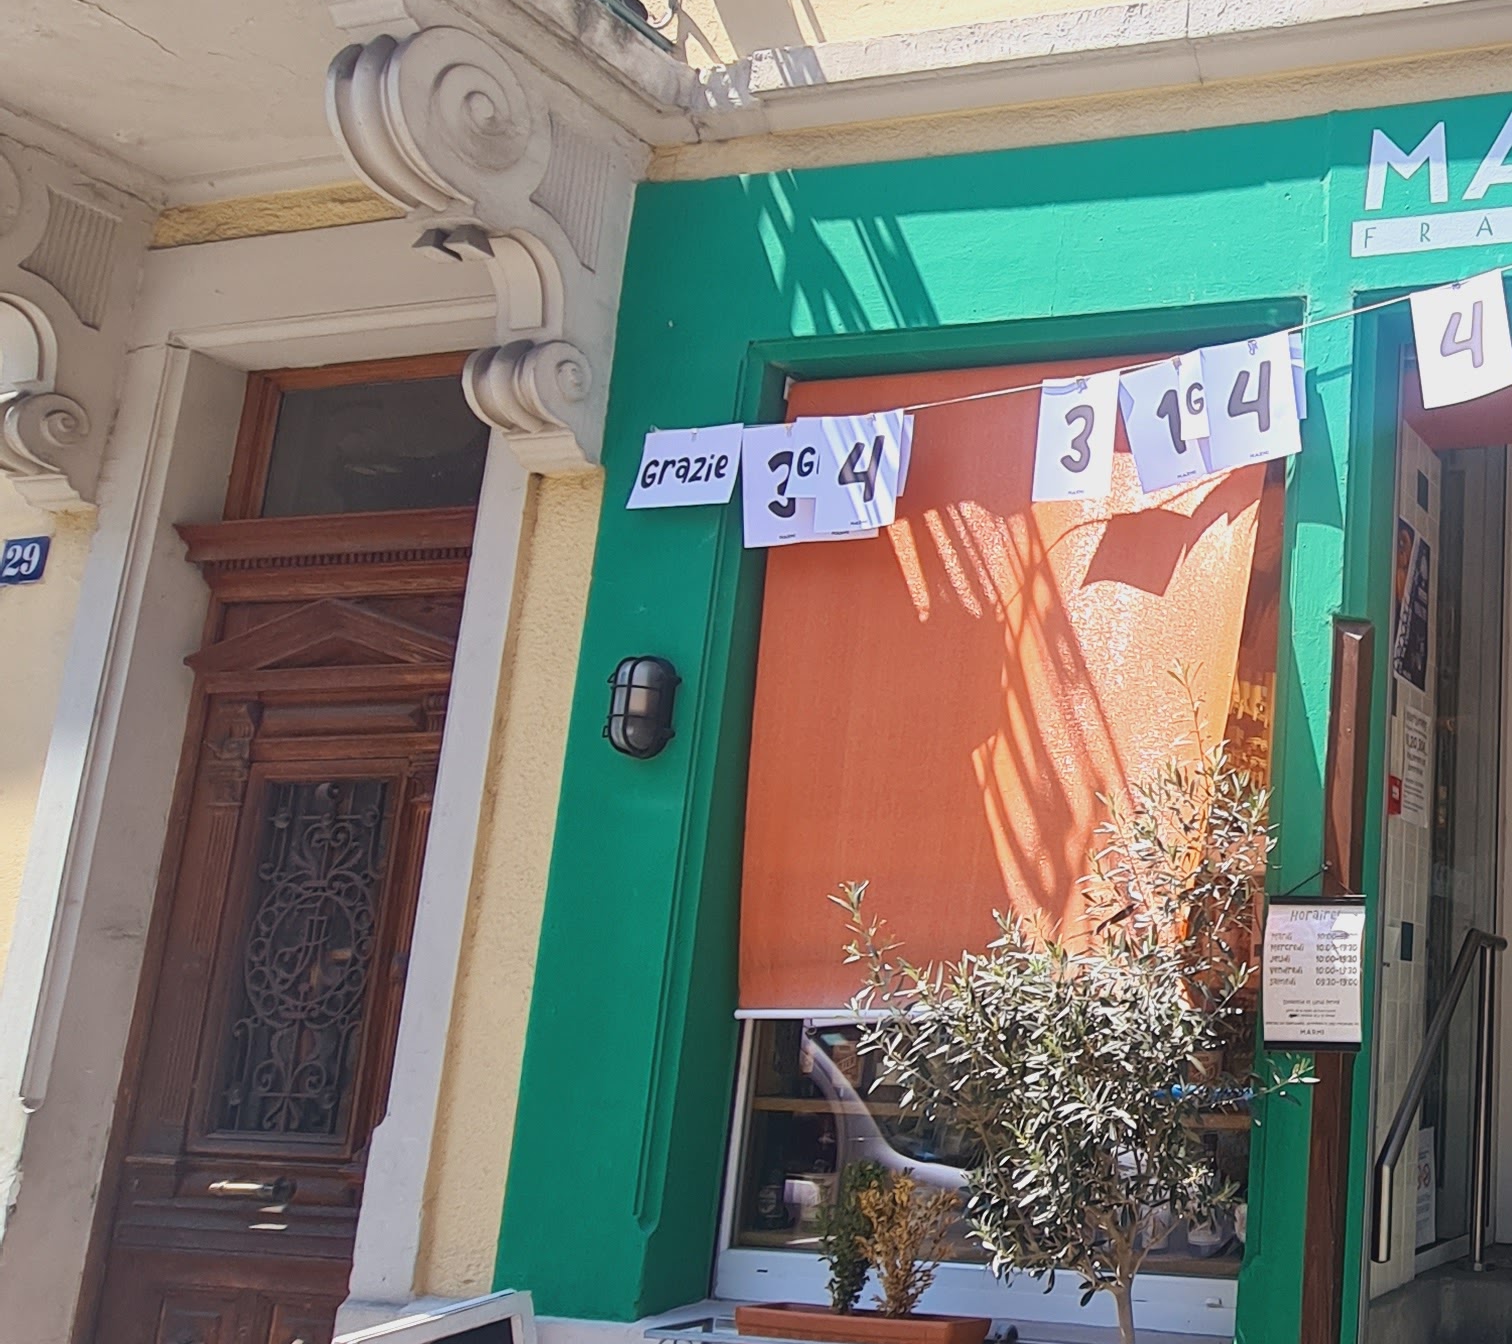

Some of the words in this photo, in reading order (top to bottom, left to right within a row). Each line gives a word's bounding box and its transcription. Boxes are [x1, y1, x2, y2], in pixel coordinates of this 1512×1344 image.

[1440, 300, 1484, 368] 4
[1157, 389, 1186, 454] 1
[1228, 360, 1271, 433] 4
[640, 453, 729, 489] Grazie
[838, 435, 885, 503] 4
[1060, 404, 1094, 473] 3
[2, 542, 40, 576] 29
